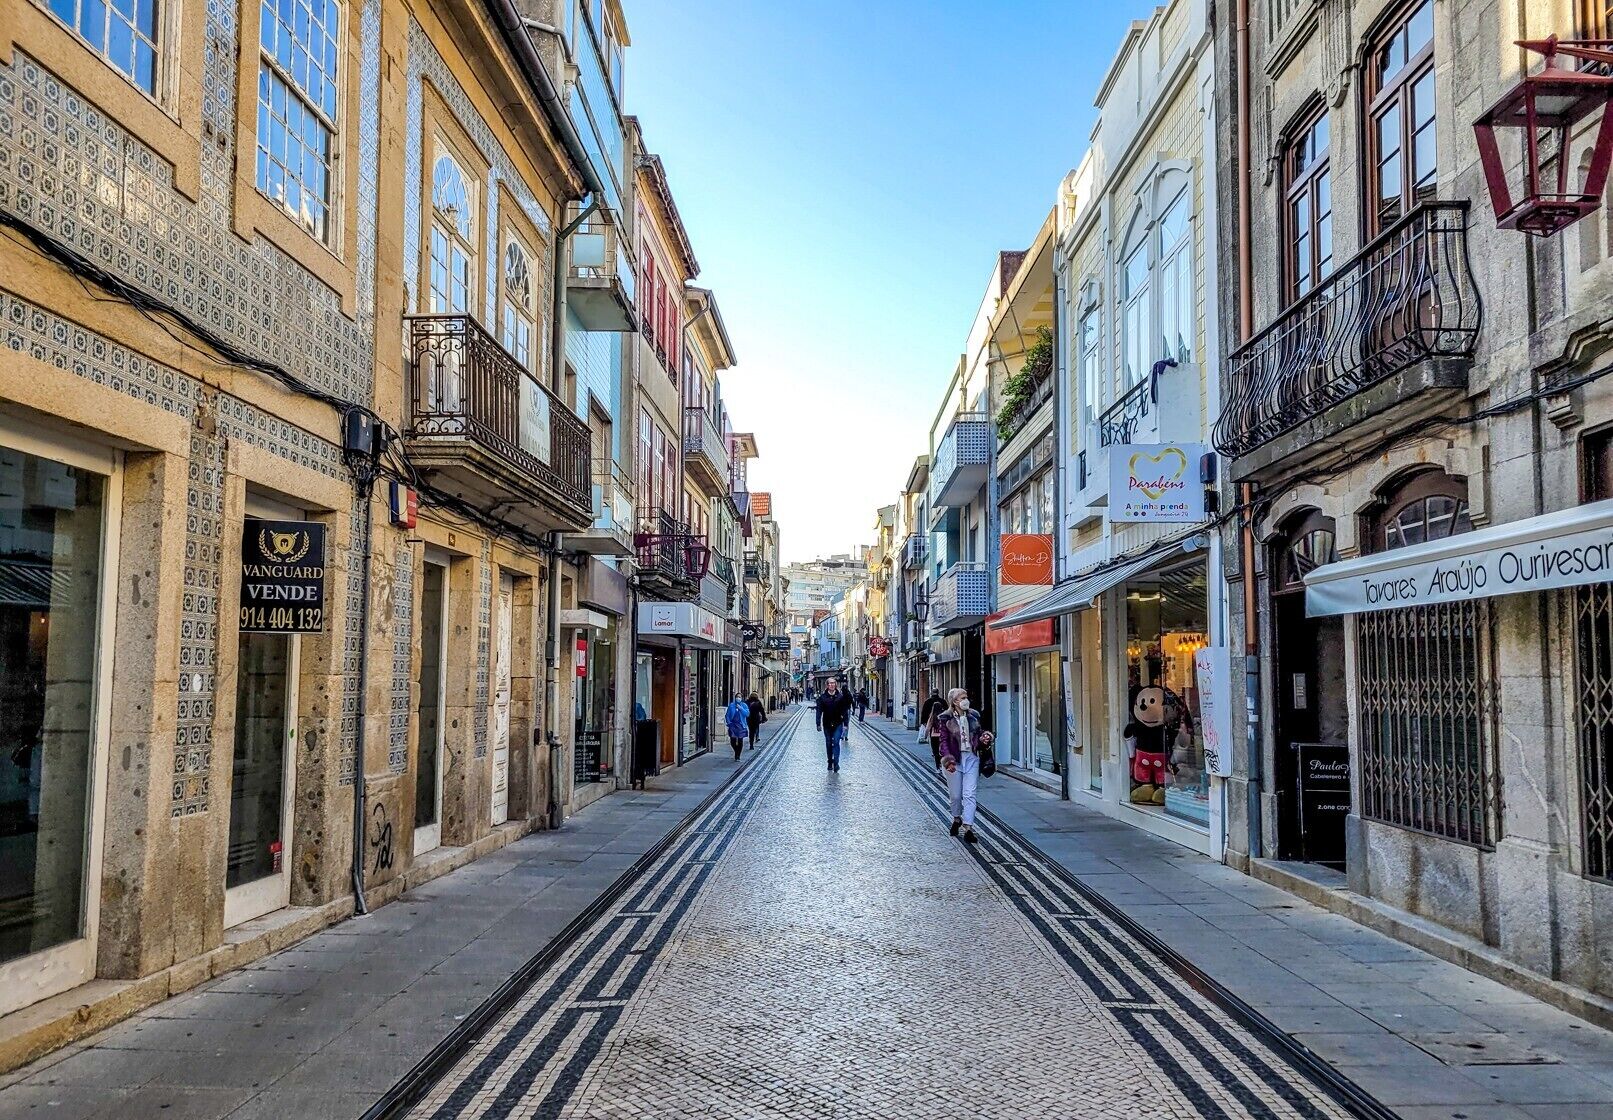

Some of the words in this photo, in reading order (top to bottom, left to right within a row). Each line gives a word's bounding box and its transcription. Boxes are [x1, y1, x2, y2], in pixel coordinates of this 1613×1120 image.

[1128, 475, 1186, 491] Parabéns
[1160, 503, 1189, 512] prenda
[242, 564, 324, 579] VANGUARD
[1362, 577, 1418, 604] Tavares
[1427, 560, 1487, 596] Araújo
[1499, 533, 1613, 584] Ourivesar
[247, 583, 318, 601] VENDE
[240, 606, 266, 628] 914
[268, 607, 294, 629] 404
[297, 608, 322, 630] 132
